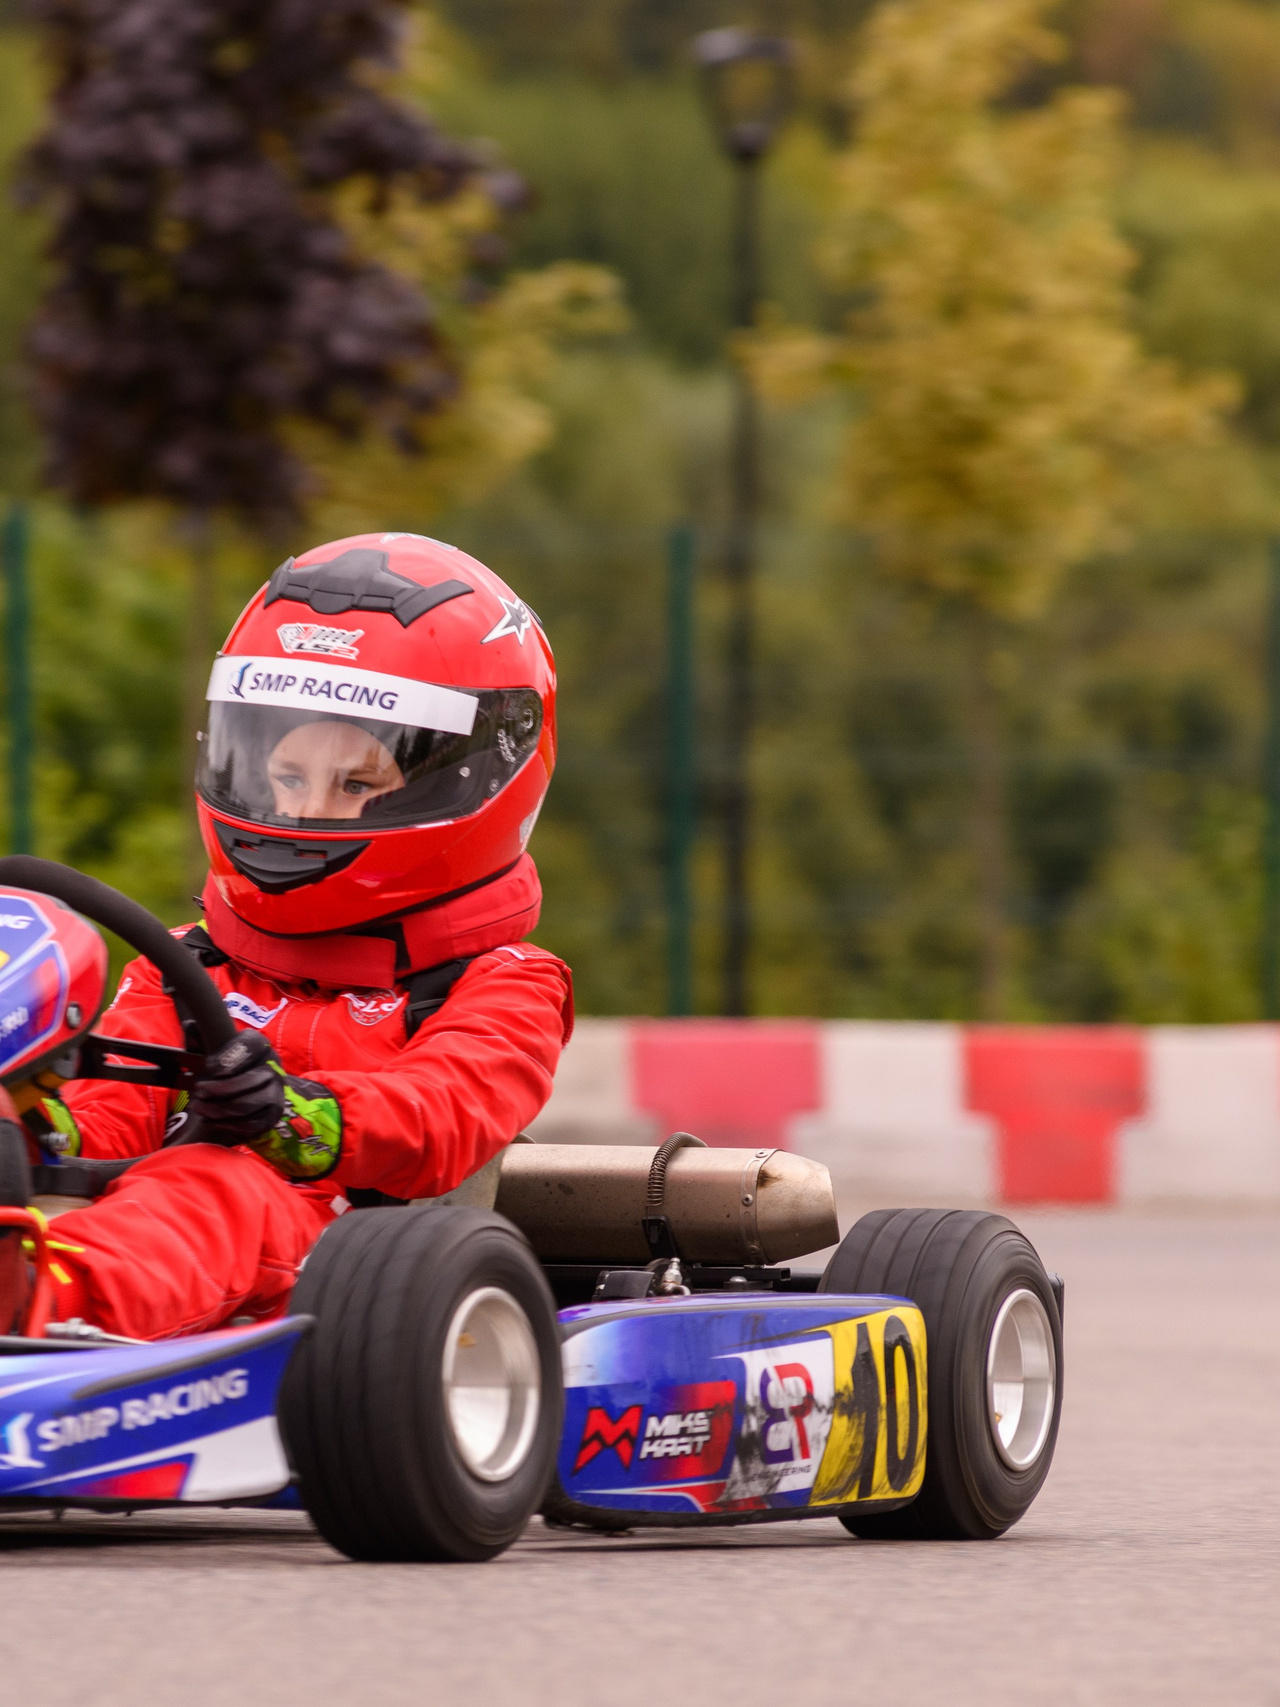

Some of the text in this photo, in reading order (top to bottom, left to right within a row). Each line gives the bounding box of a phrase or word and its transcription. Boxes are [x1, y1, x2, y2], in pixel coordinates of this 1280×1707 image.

[249, 672, 400, 711] SMP RACING
[36, 1368, 250, 1452] SMP RACING
[644, 1410, 712, 1438] MIKS
[851, 1315, 919, 1500] 10
[639, 1434, 712, 1460] KART
